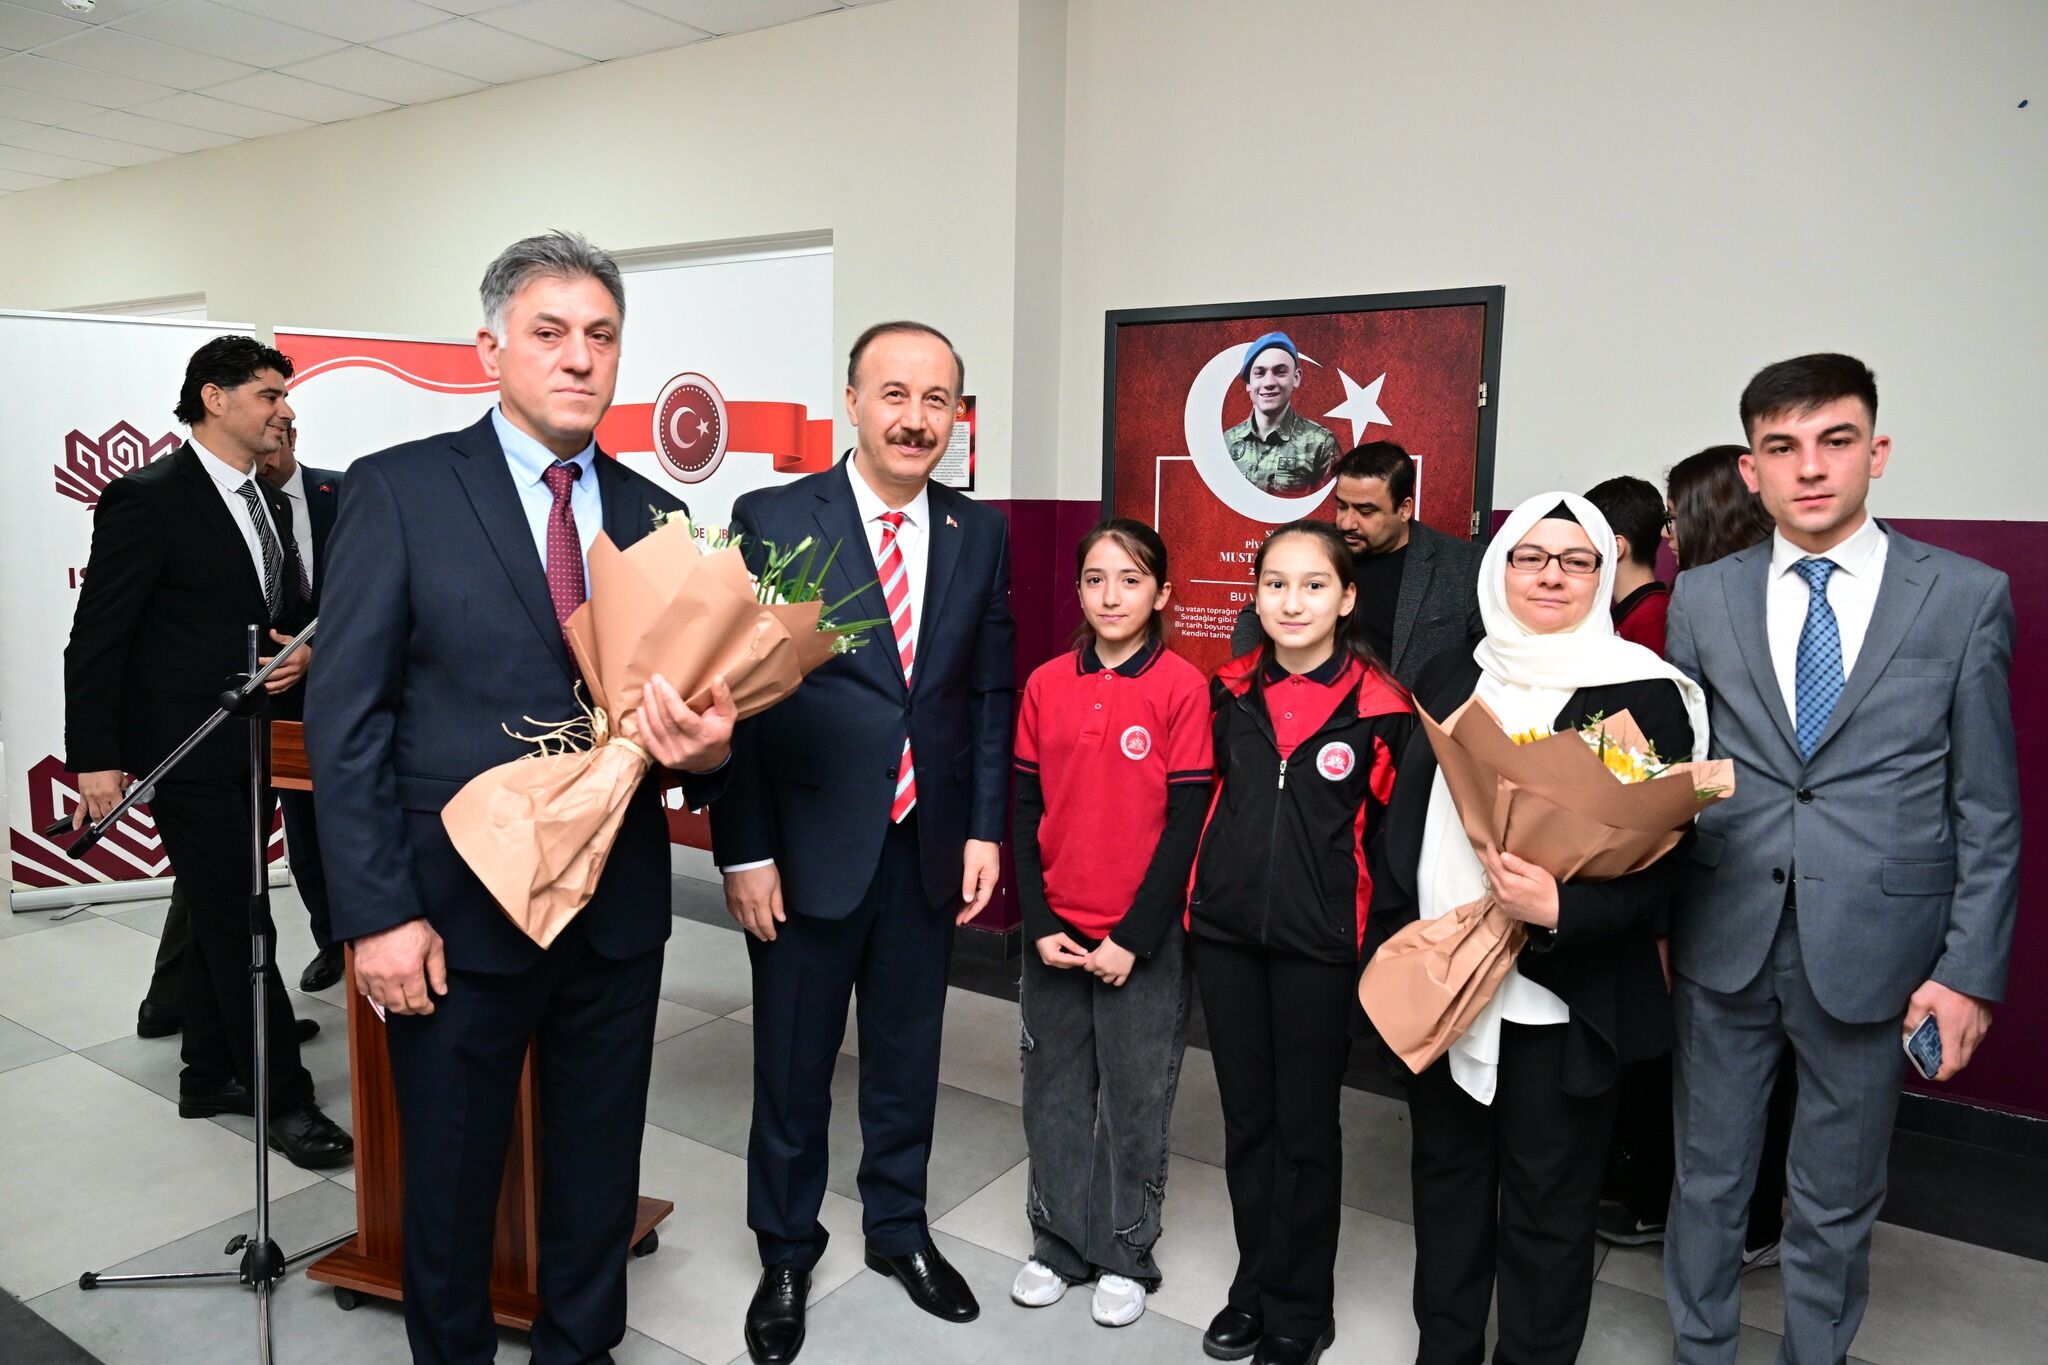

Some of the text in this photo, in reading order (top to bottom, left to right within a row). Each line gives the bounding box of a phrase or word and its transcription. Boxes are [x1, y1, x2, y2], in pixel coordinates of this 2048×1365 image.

[1230, 592, 1246, 602] BU
[1207, 607, 1237, 616] toprağın
[1181, 613, 1216, 623] Sıradağlar
[1186, 621, 1203, 629] tarih
[1204, 623, 1235, 632] boyunca
[1181, 629, 1231, 639] Kendini tarihe
